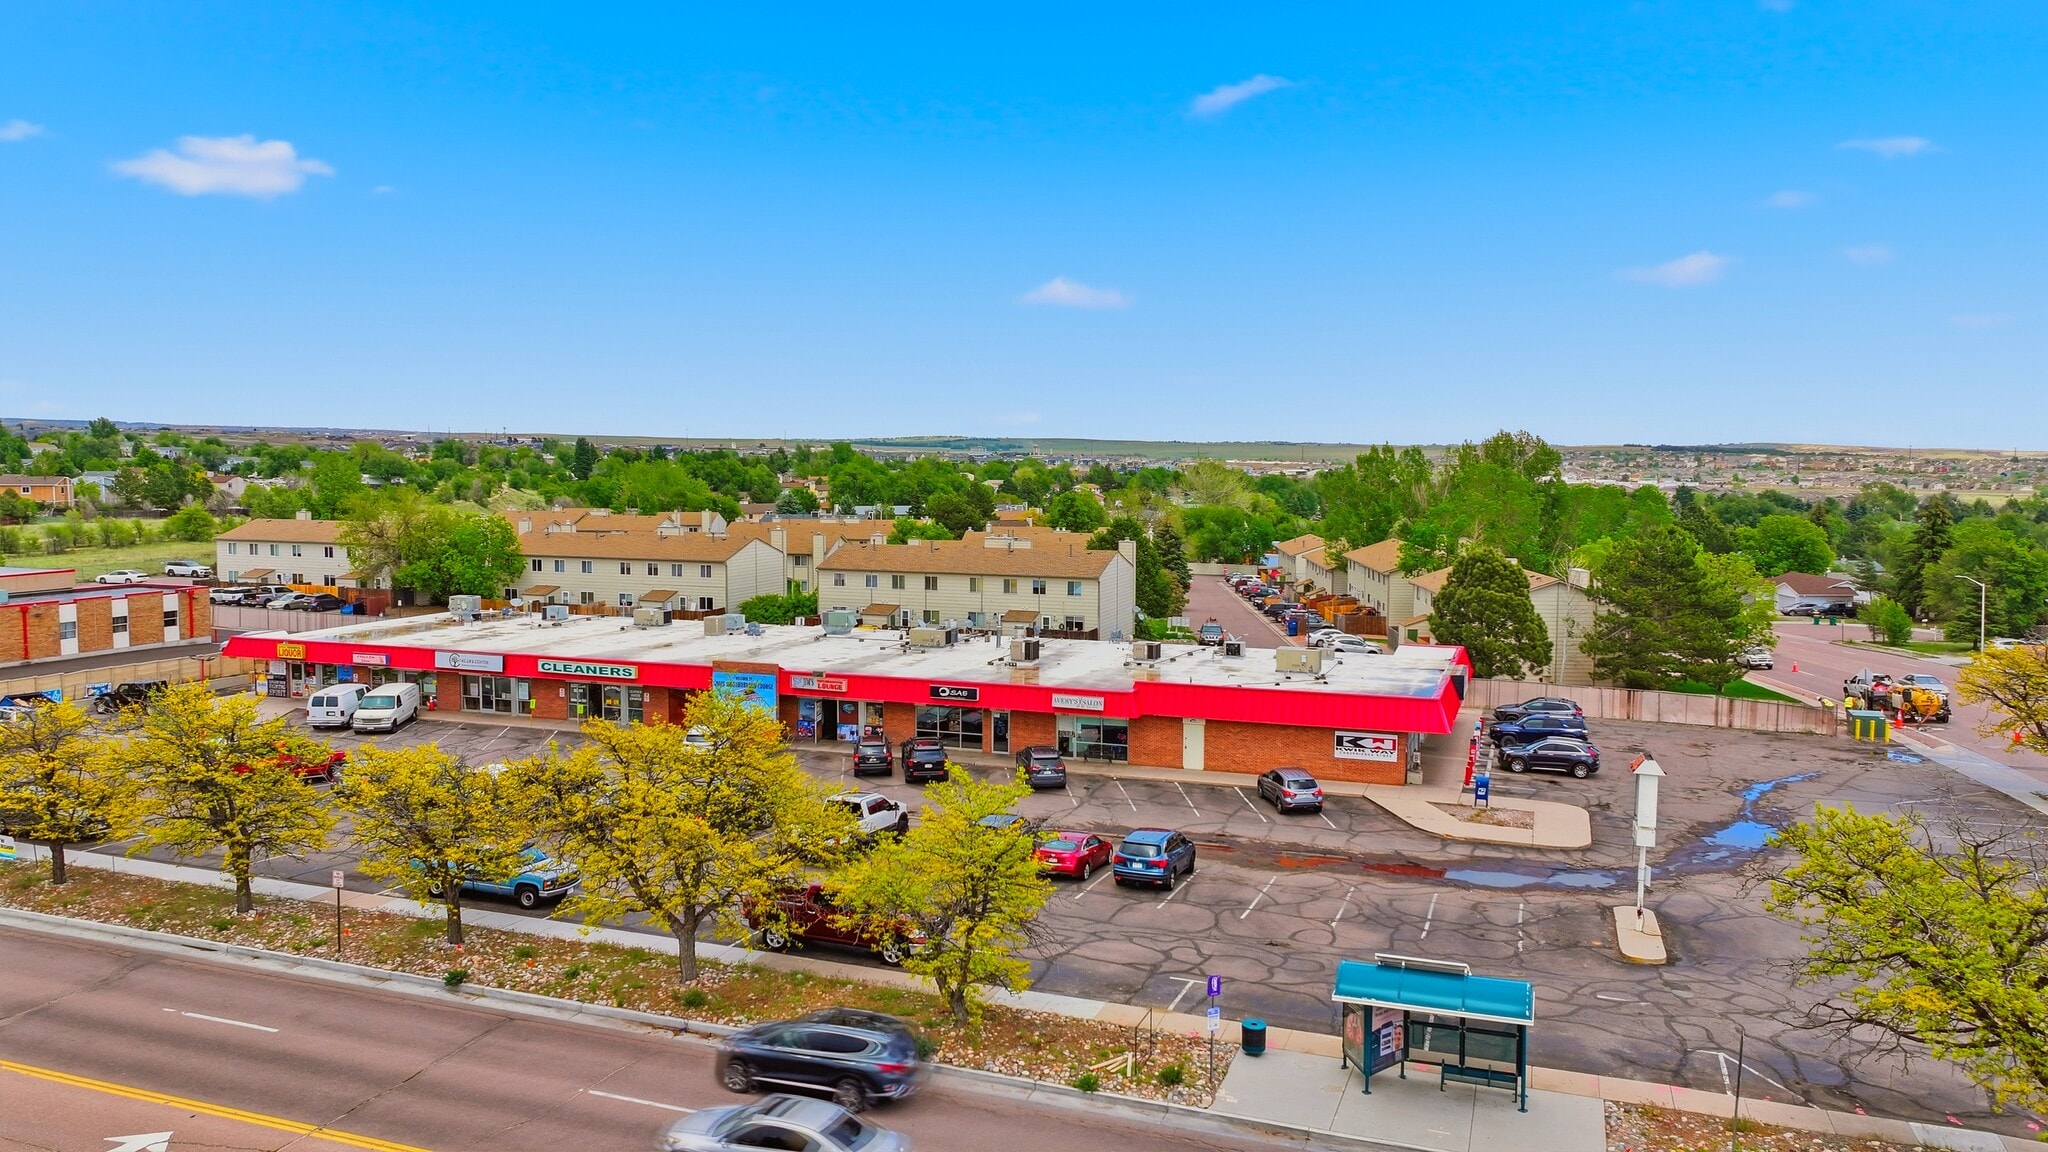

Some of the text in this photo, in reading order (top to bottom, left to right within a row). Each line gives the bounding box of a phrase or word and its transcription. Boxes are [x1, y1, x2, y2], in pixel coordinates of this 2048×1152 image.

[278, 648, 302, 658] LIQUOR
[540, 662, 633, 677] CLEANERS
[817, 682, 843, 690] LOUNGE
